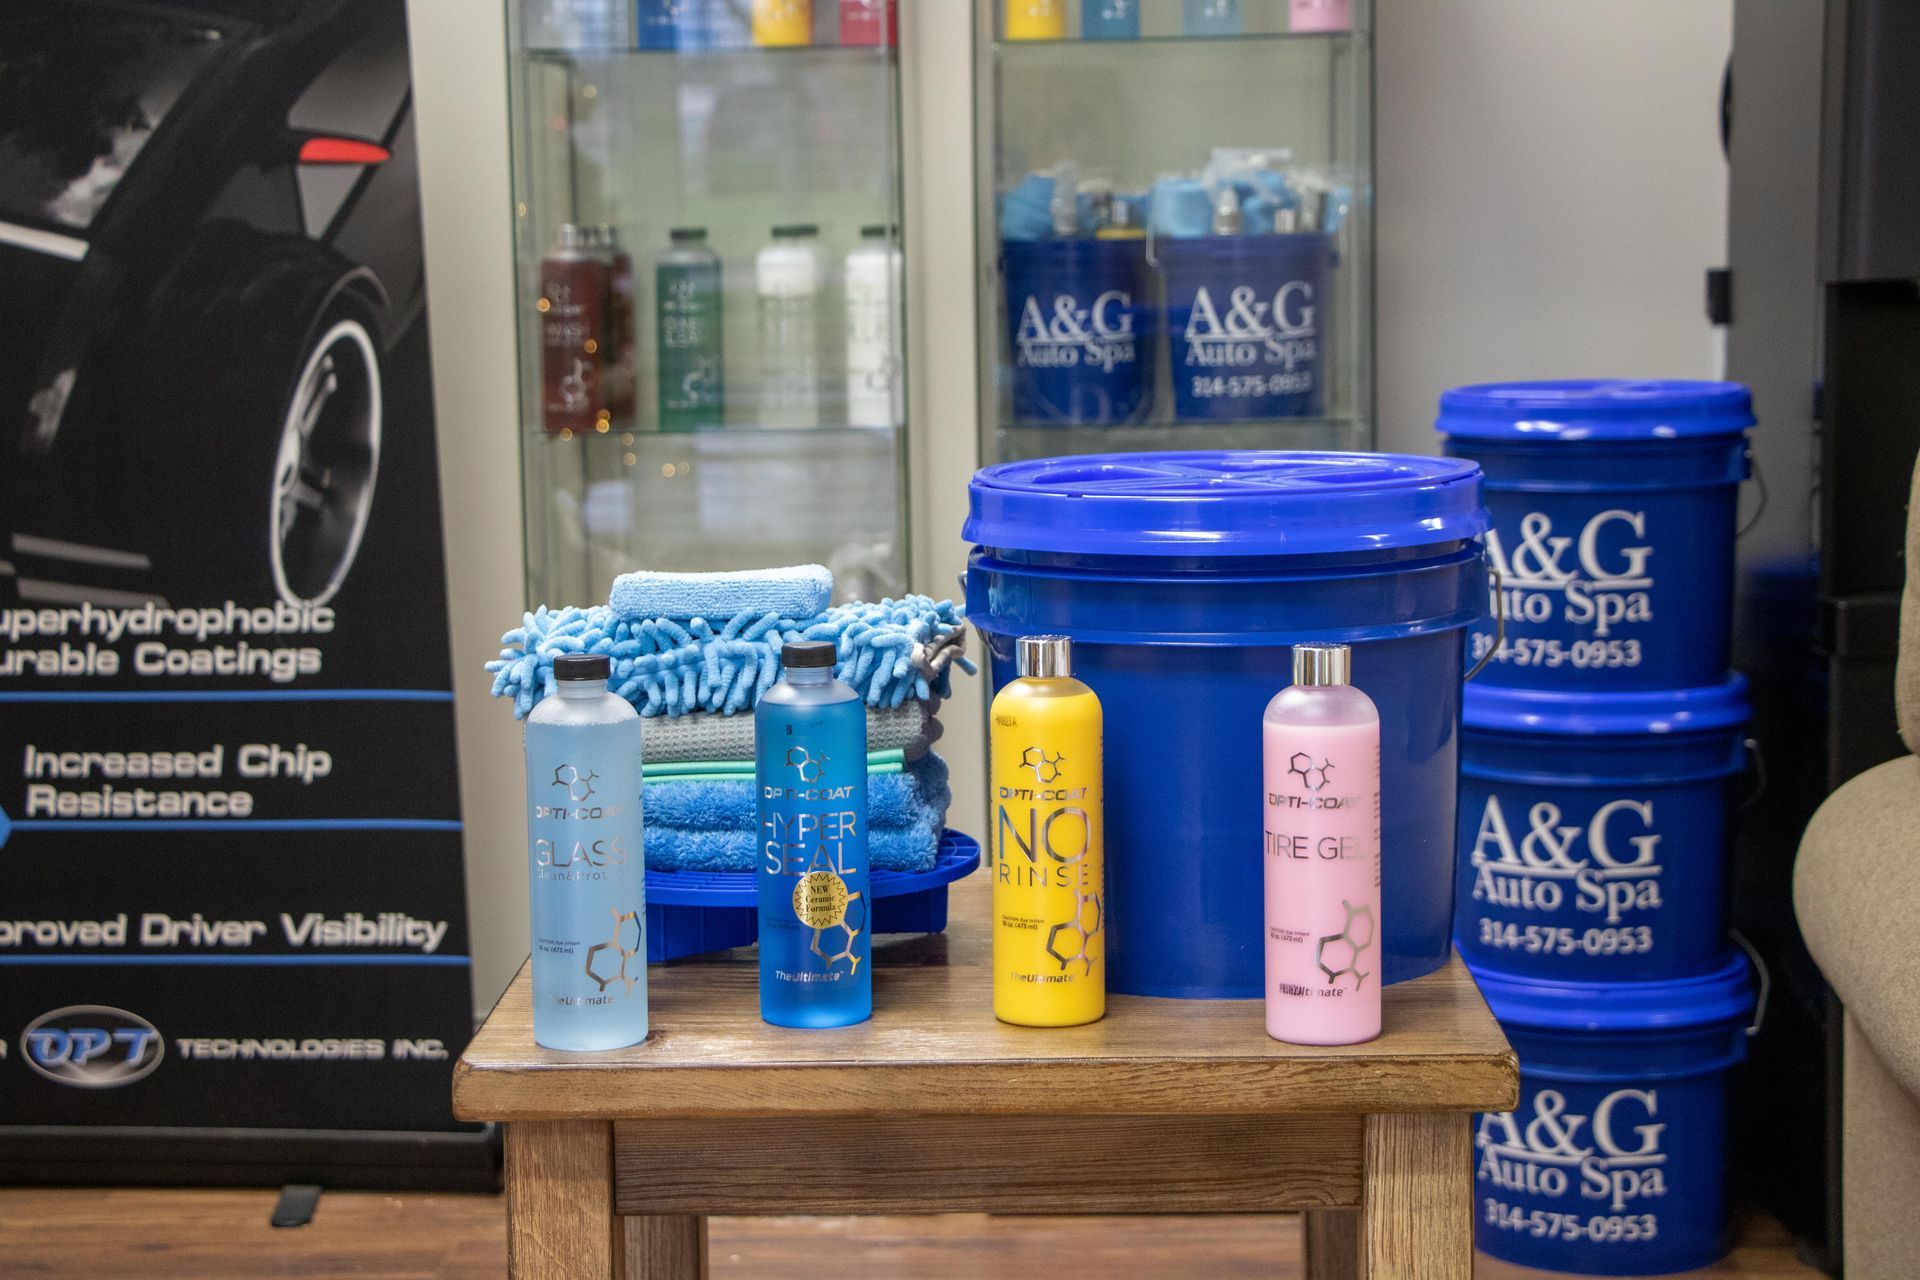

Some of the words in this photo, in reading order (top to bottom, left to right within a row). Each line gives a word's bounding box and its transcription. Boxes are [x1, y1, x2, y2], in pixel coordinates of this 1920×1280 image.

[1016, 290, 1134, 343] A&G
[1184, 280, 1316, 341] A&G
[1017, 342, 1080, 368] Auto
[1084, 336, 1136, 373] Spa
[1185, 341, 1258, 367] Auto
[1263, 333, 1316, 371] Spa
[1489, 588, 1552, 624] uto
[1564, 579, 1653, 637] Spa
[133, 641, 322, 682] Coatings
[23, 744, 224, 778] Increased
[237, 743, 332, 785] Chip
[26, 784, 254, 818] Resistance
[536, 805, 624, 820] OPTI-COA
[764, 786, 855, 801] OPTI-COAT
[1000, 786, 1088, 801] OPTI-COAT
[762, 811, 857, 841] HYPER
[999, 805, 1091, 864] NO
[1265, 830, 1309, 859] TIRE
[1470, 794, 1663, 870] A&G
[536, 838, 625, 867] GLASS
[765, 840, 857, 876] SEAL
[810, 885, 828, 894] NEW
[1000, 862, 1088, 887] RINSE
[1473, 862, 1563, 911] Auto
[1575, 868, 1664, 924] Spa
[805, 895, 835, 903] Ceramic
[806, 903, 836, 912] Formula
[139, 913, 267, 947] Driver
[280, 913, 448, 953] Visibility
[1479, 917, 1653, 955] 314-575-0953
[28, 1027, 157, 1066] OPT
[175, 1038, 384, 1059] TECHNOLOGIES
[392, 1038, 449, 1060] INC.
[1475, 1089, 1668, 1158] A&G
[1477, 1143, 1568, 1197] Auto
[1580, 1155, 1669, 1211] Spa
[1484, 1198, 1658, 1242] 314-575-0953
